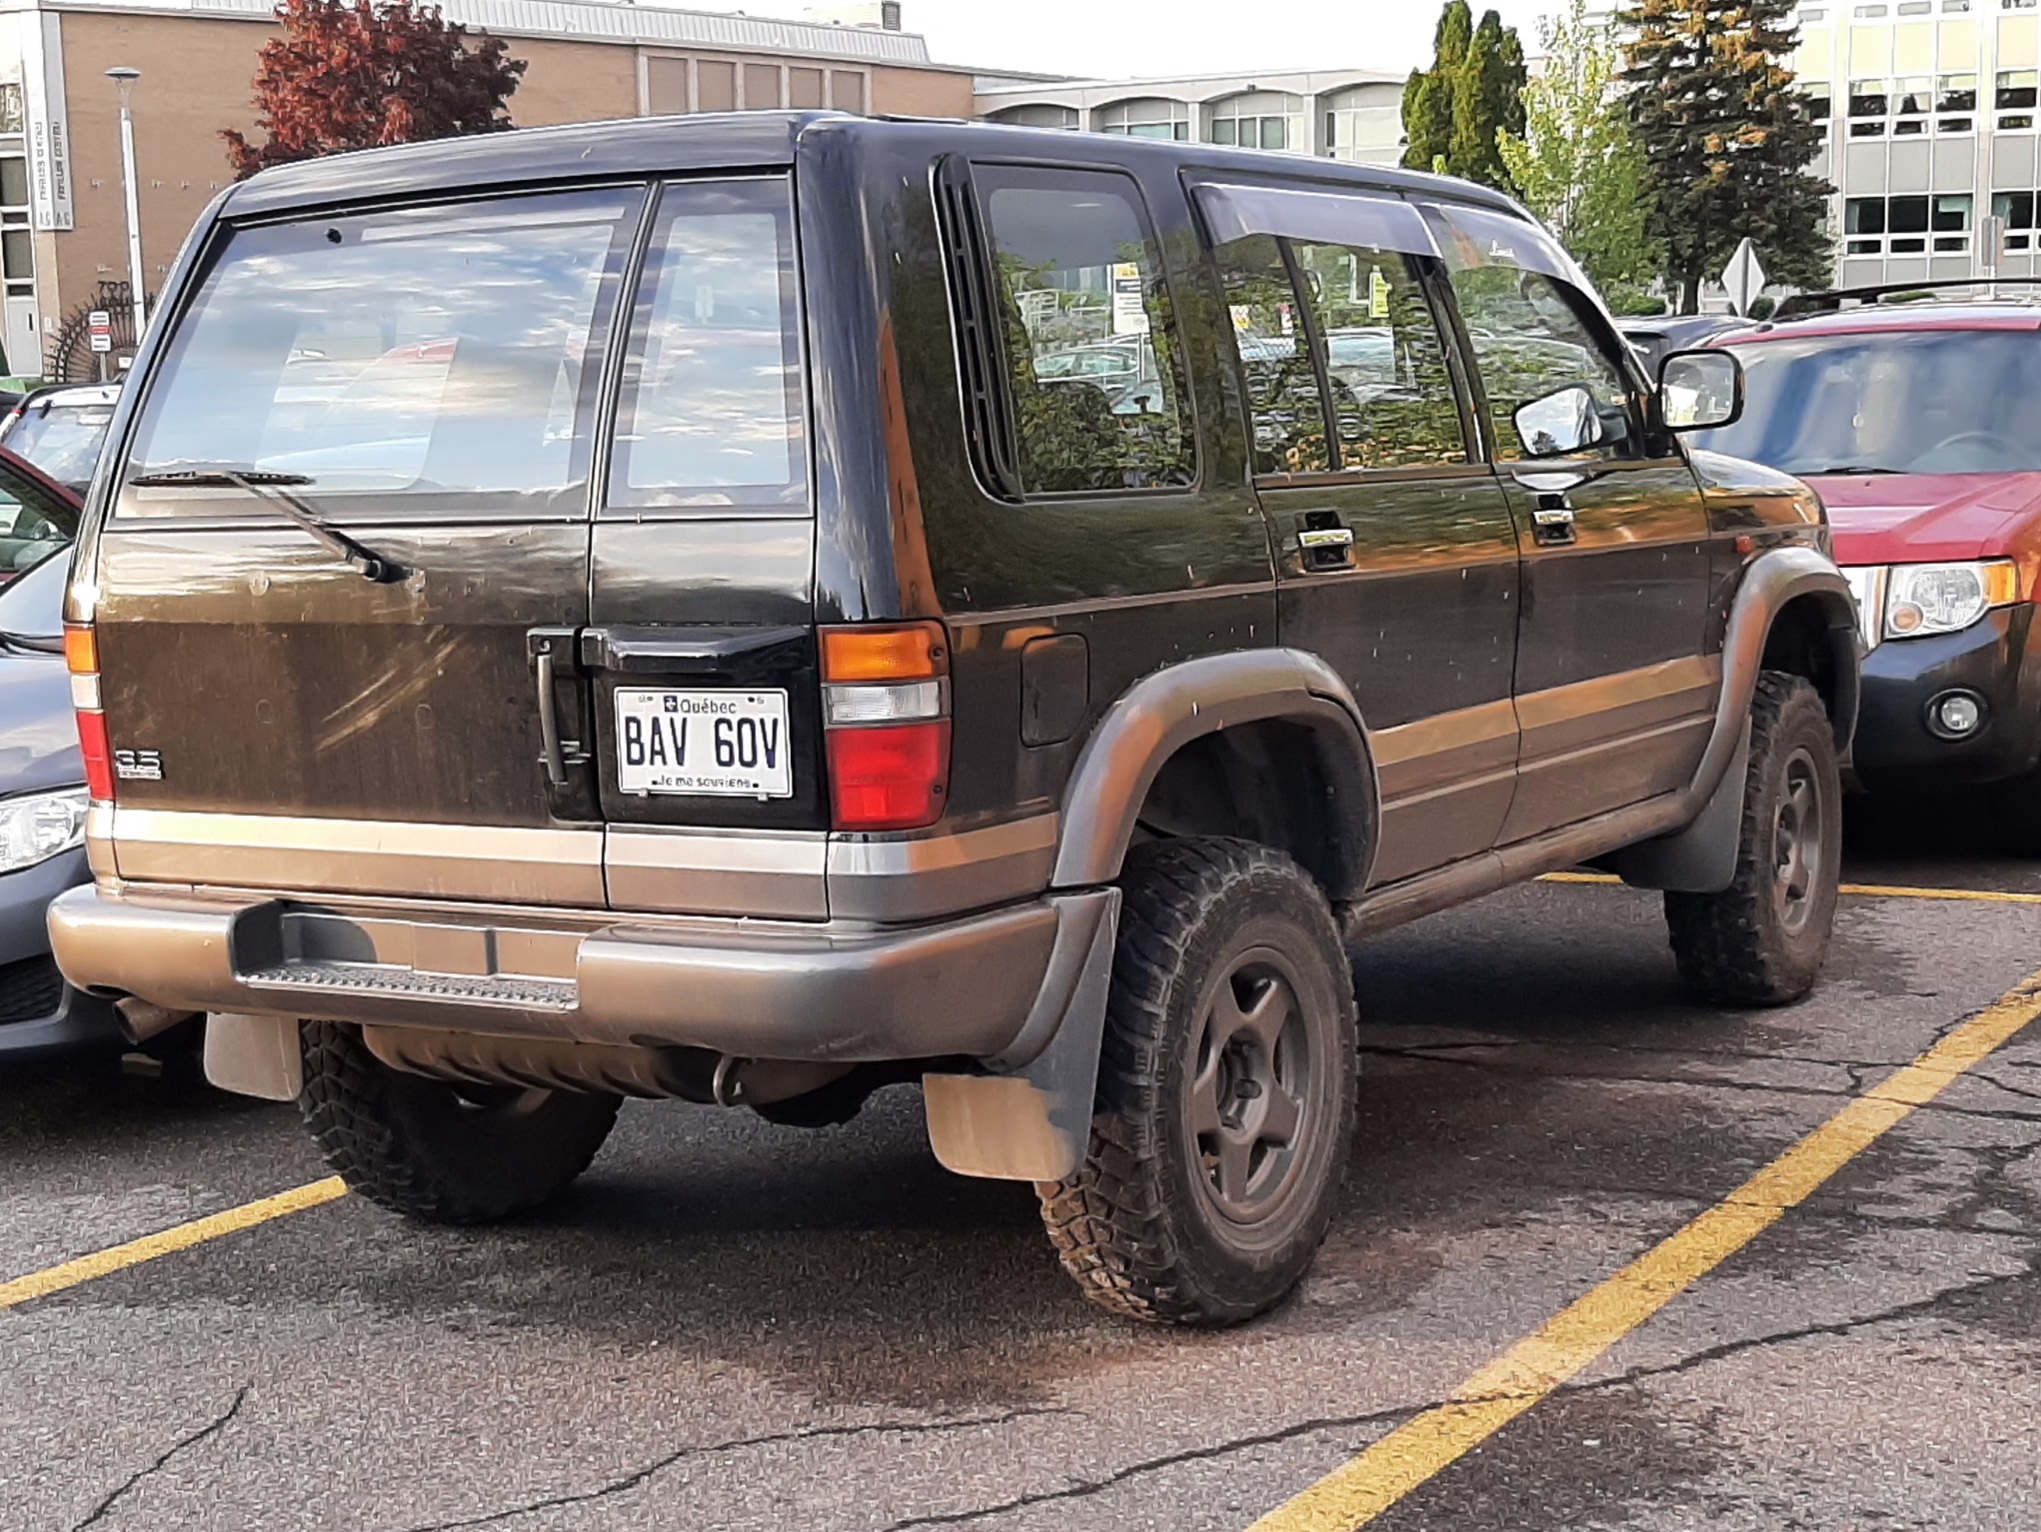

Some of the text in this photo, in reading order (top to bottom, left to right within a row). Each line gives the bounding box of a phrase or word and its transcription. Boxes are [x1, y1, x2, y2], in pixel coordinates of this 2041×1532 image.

[680, 698, 737, 714] Québec
[625, 716, 778, 769] BAV 60V
